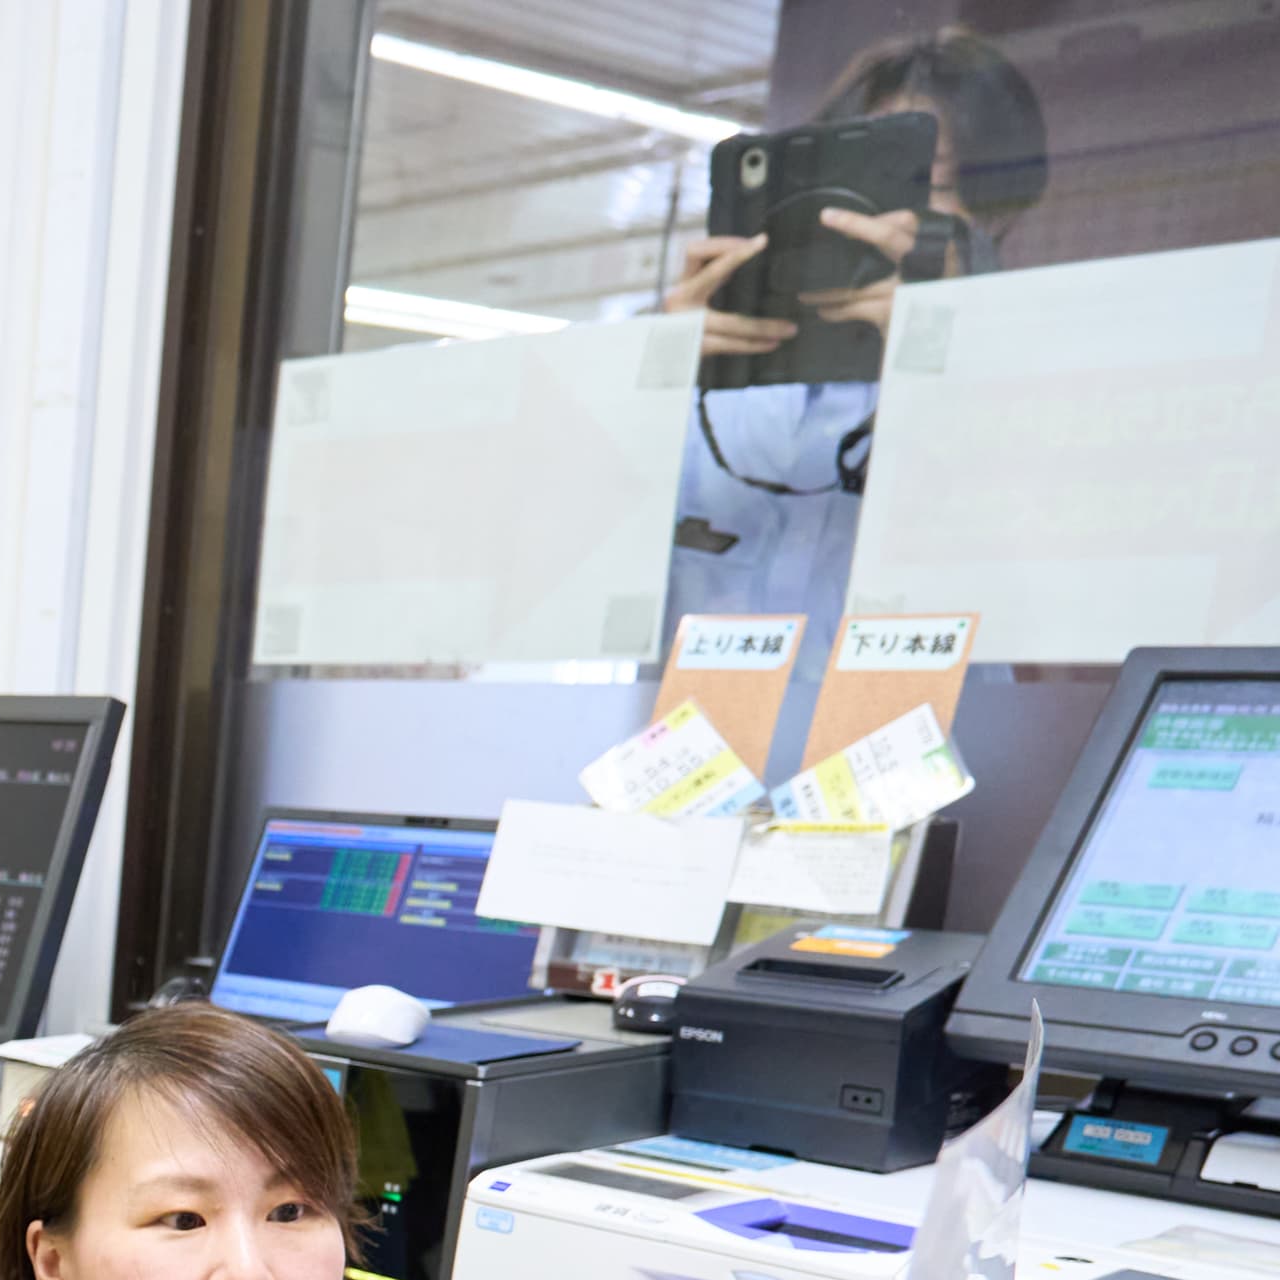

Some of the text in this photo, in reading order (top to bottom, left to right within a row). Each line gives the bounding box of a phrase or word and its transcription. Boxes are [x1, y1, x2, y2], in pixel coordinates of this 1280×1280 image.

[686, 632, 785, 656] 上り本線
[851, 632, 957, 656] 下り本線
[680, 1026, 723, 1043] EPSON
